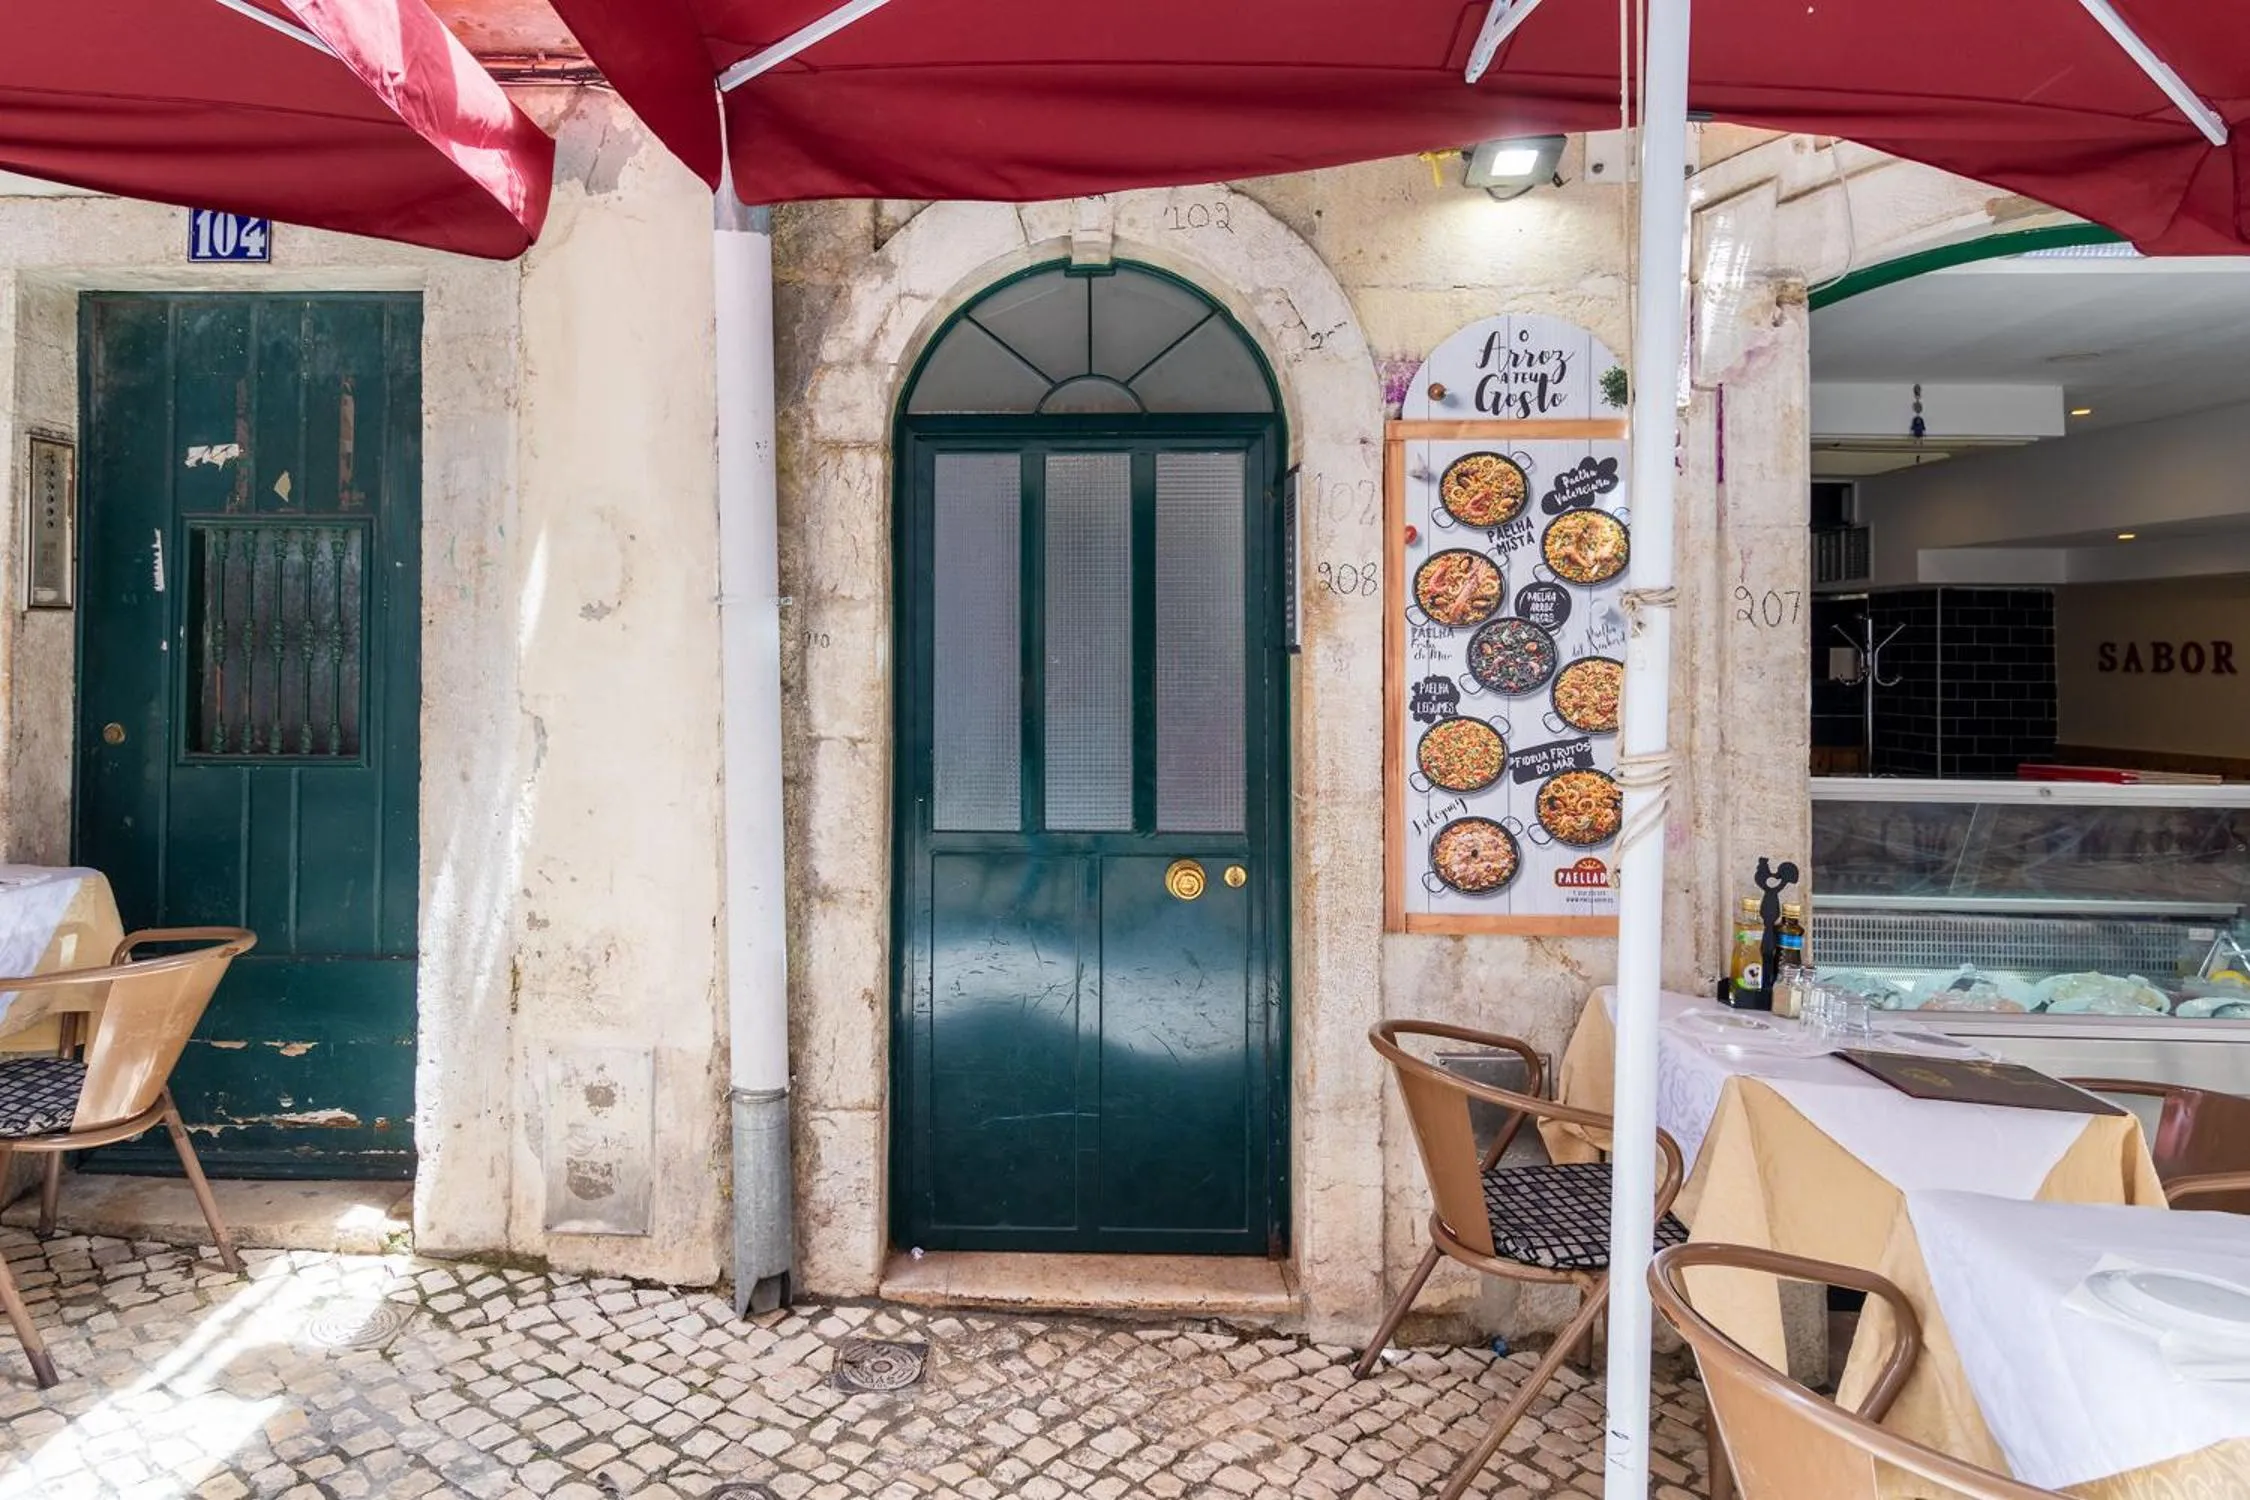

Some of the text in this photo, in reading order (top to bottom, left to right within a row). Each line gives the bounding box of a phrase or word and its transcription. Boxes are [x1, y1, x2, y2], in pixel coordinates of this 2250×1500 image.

[195, 209, 266, 257] 104
[1475, 331, 1575, 385] Arroz
[1475, 372, 1568, 419] Gosto
[1487, 516, 1534, 543] PAELHA
[1496, 531, 1536, 555] MISTA
[1318, 561, 1378, 597] 208
[1734, 585, 1801, 628] 207
[2097, 640, 2239, 675] SABOR
[1536, 757, 1576, 775] DO MAR
[1550, 742, 1591, 760] FRUTOS
[1558, 872, 1606, 885] PAELLAD
